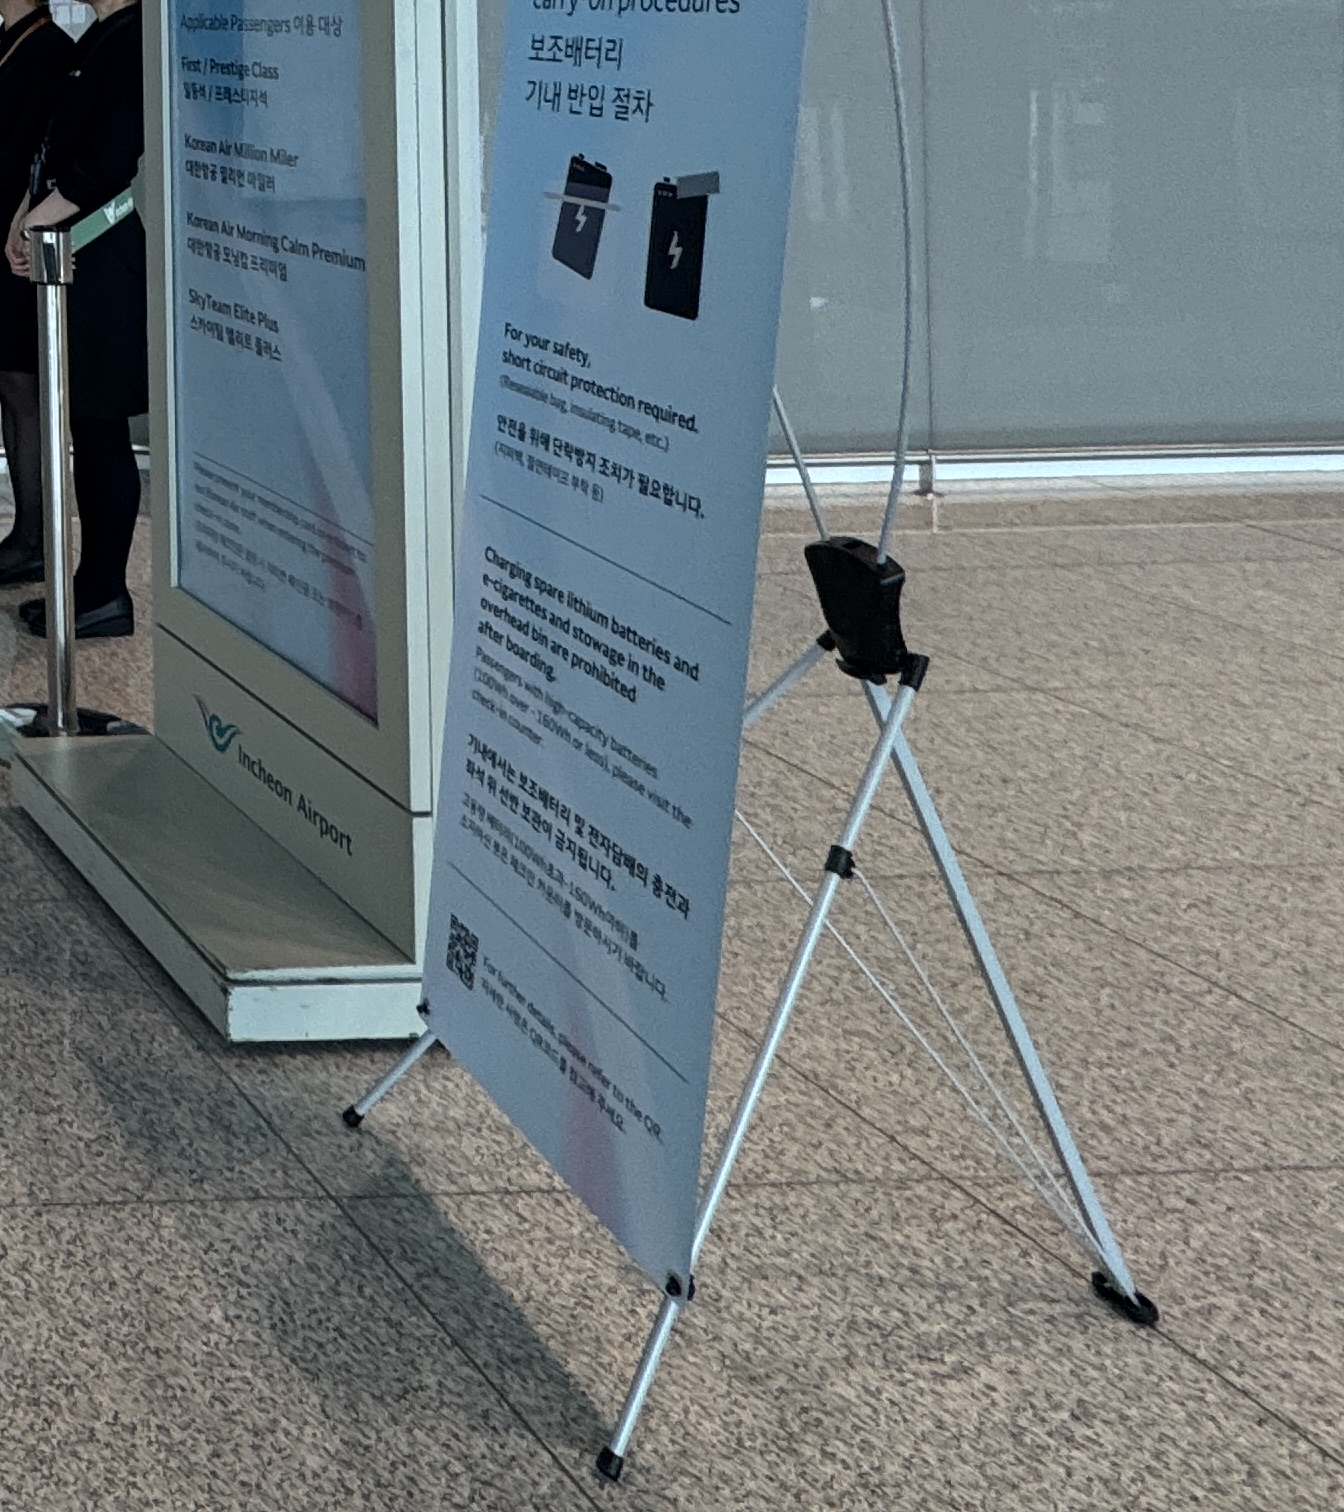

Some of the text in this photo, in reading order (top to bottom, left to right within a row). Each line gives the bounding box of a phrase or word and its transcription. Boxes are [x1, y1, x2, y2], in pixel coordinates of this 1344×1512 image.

[293, 14, 315, 36] 이용
[318, 15, 344, 37] 대상
[528, 34, 624, 71] 보조배터리
[210, 58, 250, 80] Prestige
[252, 61, 280, 80] Class
[525, 80, 654, 123] 기내 반입 절차
[187, 211, 366, 272] Korean Air Morning Calm Premium
[189, 288, 279, 334] SkyTeam Elite Plus
[504, 322, 591, 368] For your safety,
[502, 348, 699, 433] short circuit protection required.
[497, 415, 705, 519] 안전을 위해 단락방지 조치가 필요합니다.
[478, 621, 504, 645] after
[483, 573, 665, 691] e-cigarettes and stowage in the
[485, 546, 699, 681] Charging spare lithium batteries and
[480, 597, 636, 703] overhead bin are prohibited
[238, 744, 352, 856] Incheon Airport
[468, 733, 516, 784] 기내에서는
[518, 771, 571, 828] 보조배터리
[588, 824, 649, 888] 전자담배의
[652, 872, 690, 920] 충전과
[555, 828, 616, 891] 금지됩니다.
